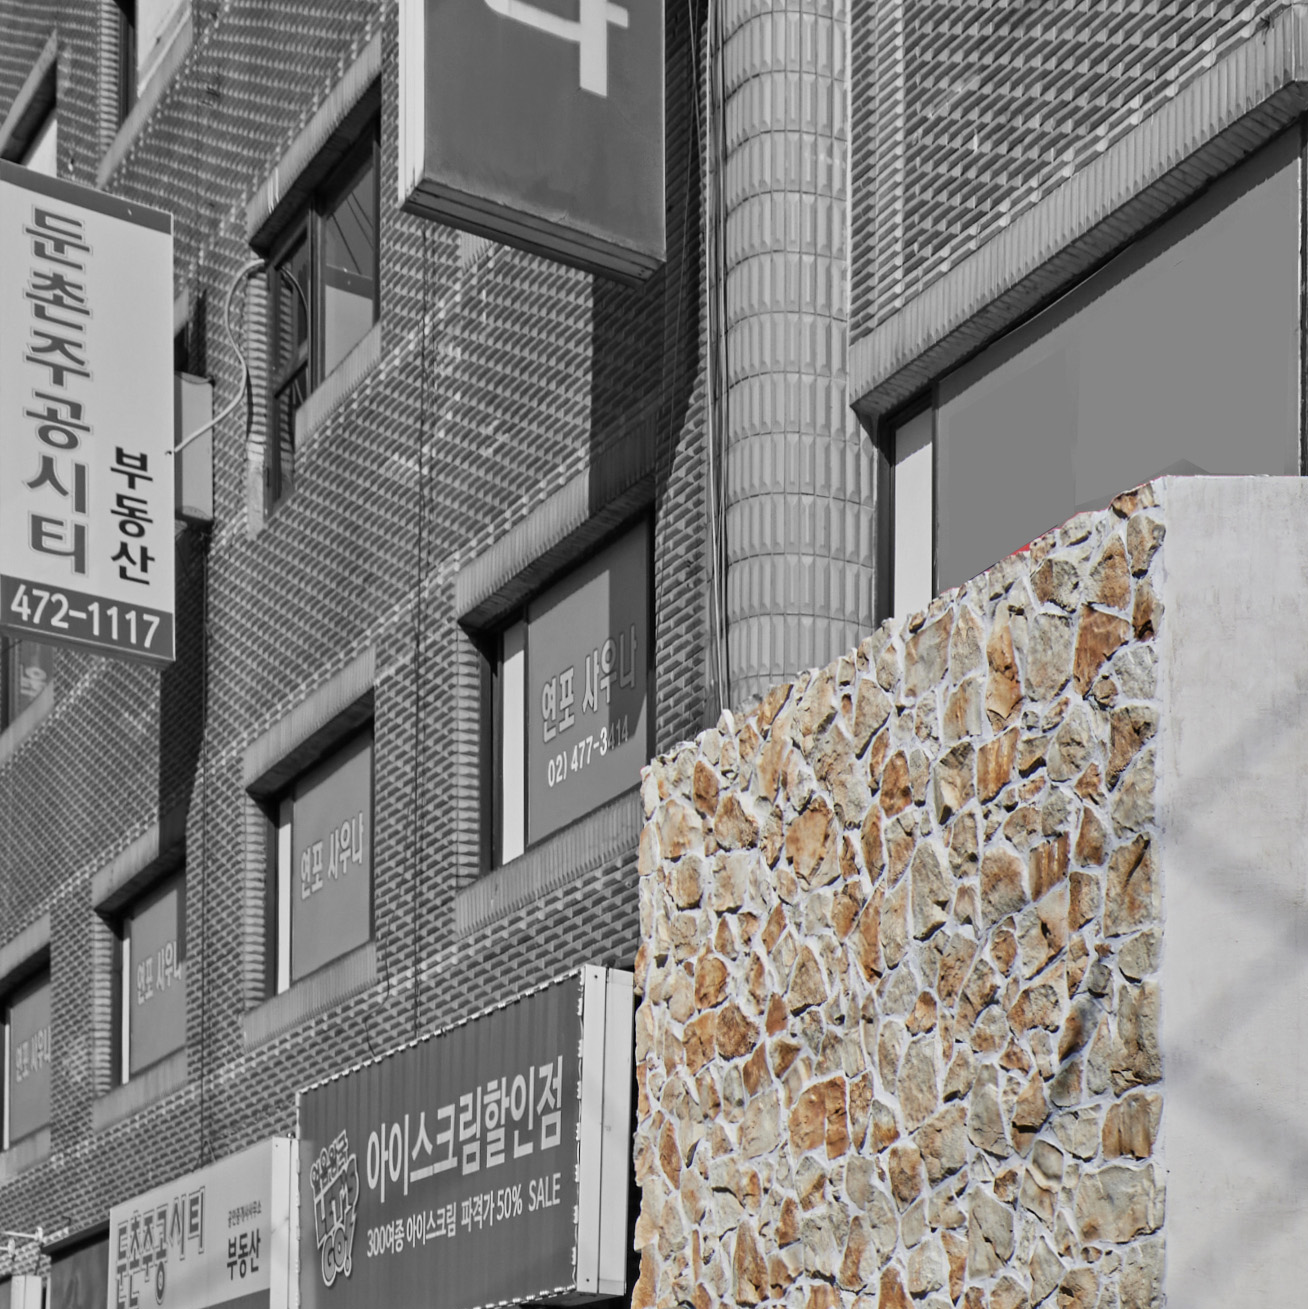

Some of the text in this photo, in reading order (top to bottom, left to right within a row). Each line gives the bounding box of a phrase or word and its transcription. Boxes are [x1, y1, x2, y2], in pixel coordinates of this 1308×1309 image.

[23, 206, 93, 578] 둔촌주공시티
[110, 446, 154, 586] 부동산
[11, 584, 160, 649] 472-1117
[541, 624, 638, 743] 연포 사우나
[547, 714, 630, 788] 02) 477-3414
[301, 810, 364, 900] 연포 사우나
[137, 957, 153, 1005] 연포
[366, 1055, 564, 1203] 아이스크림할인점
[227, 1228, 261, 1280] 부동산
[366, 1172, 562, 1257] 300여종 아이스크림 파격가 50% SALE
